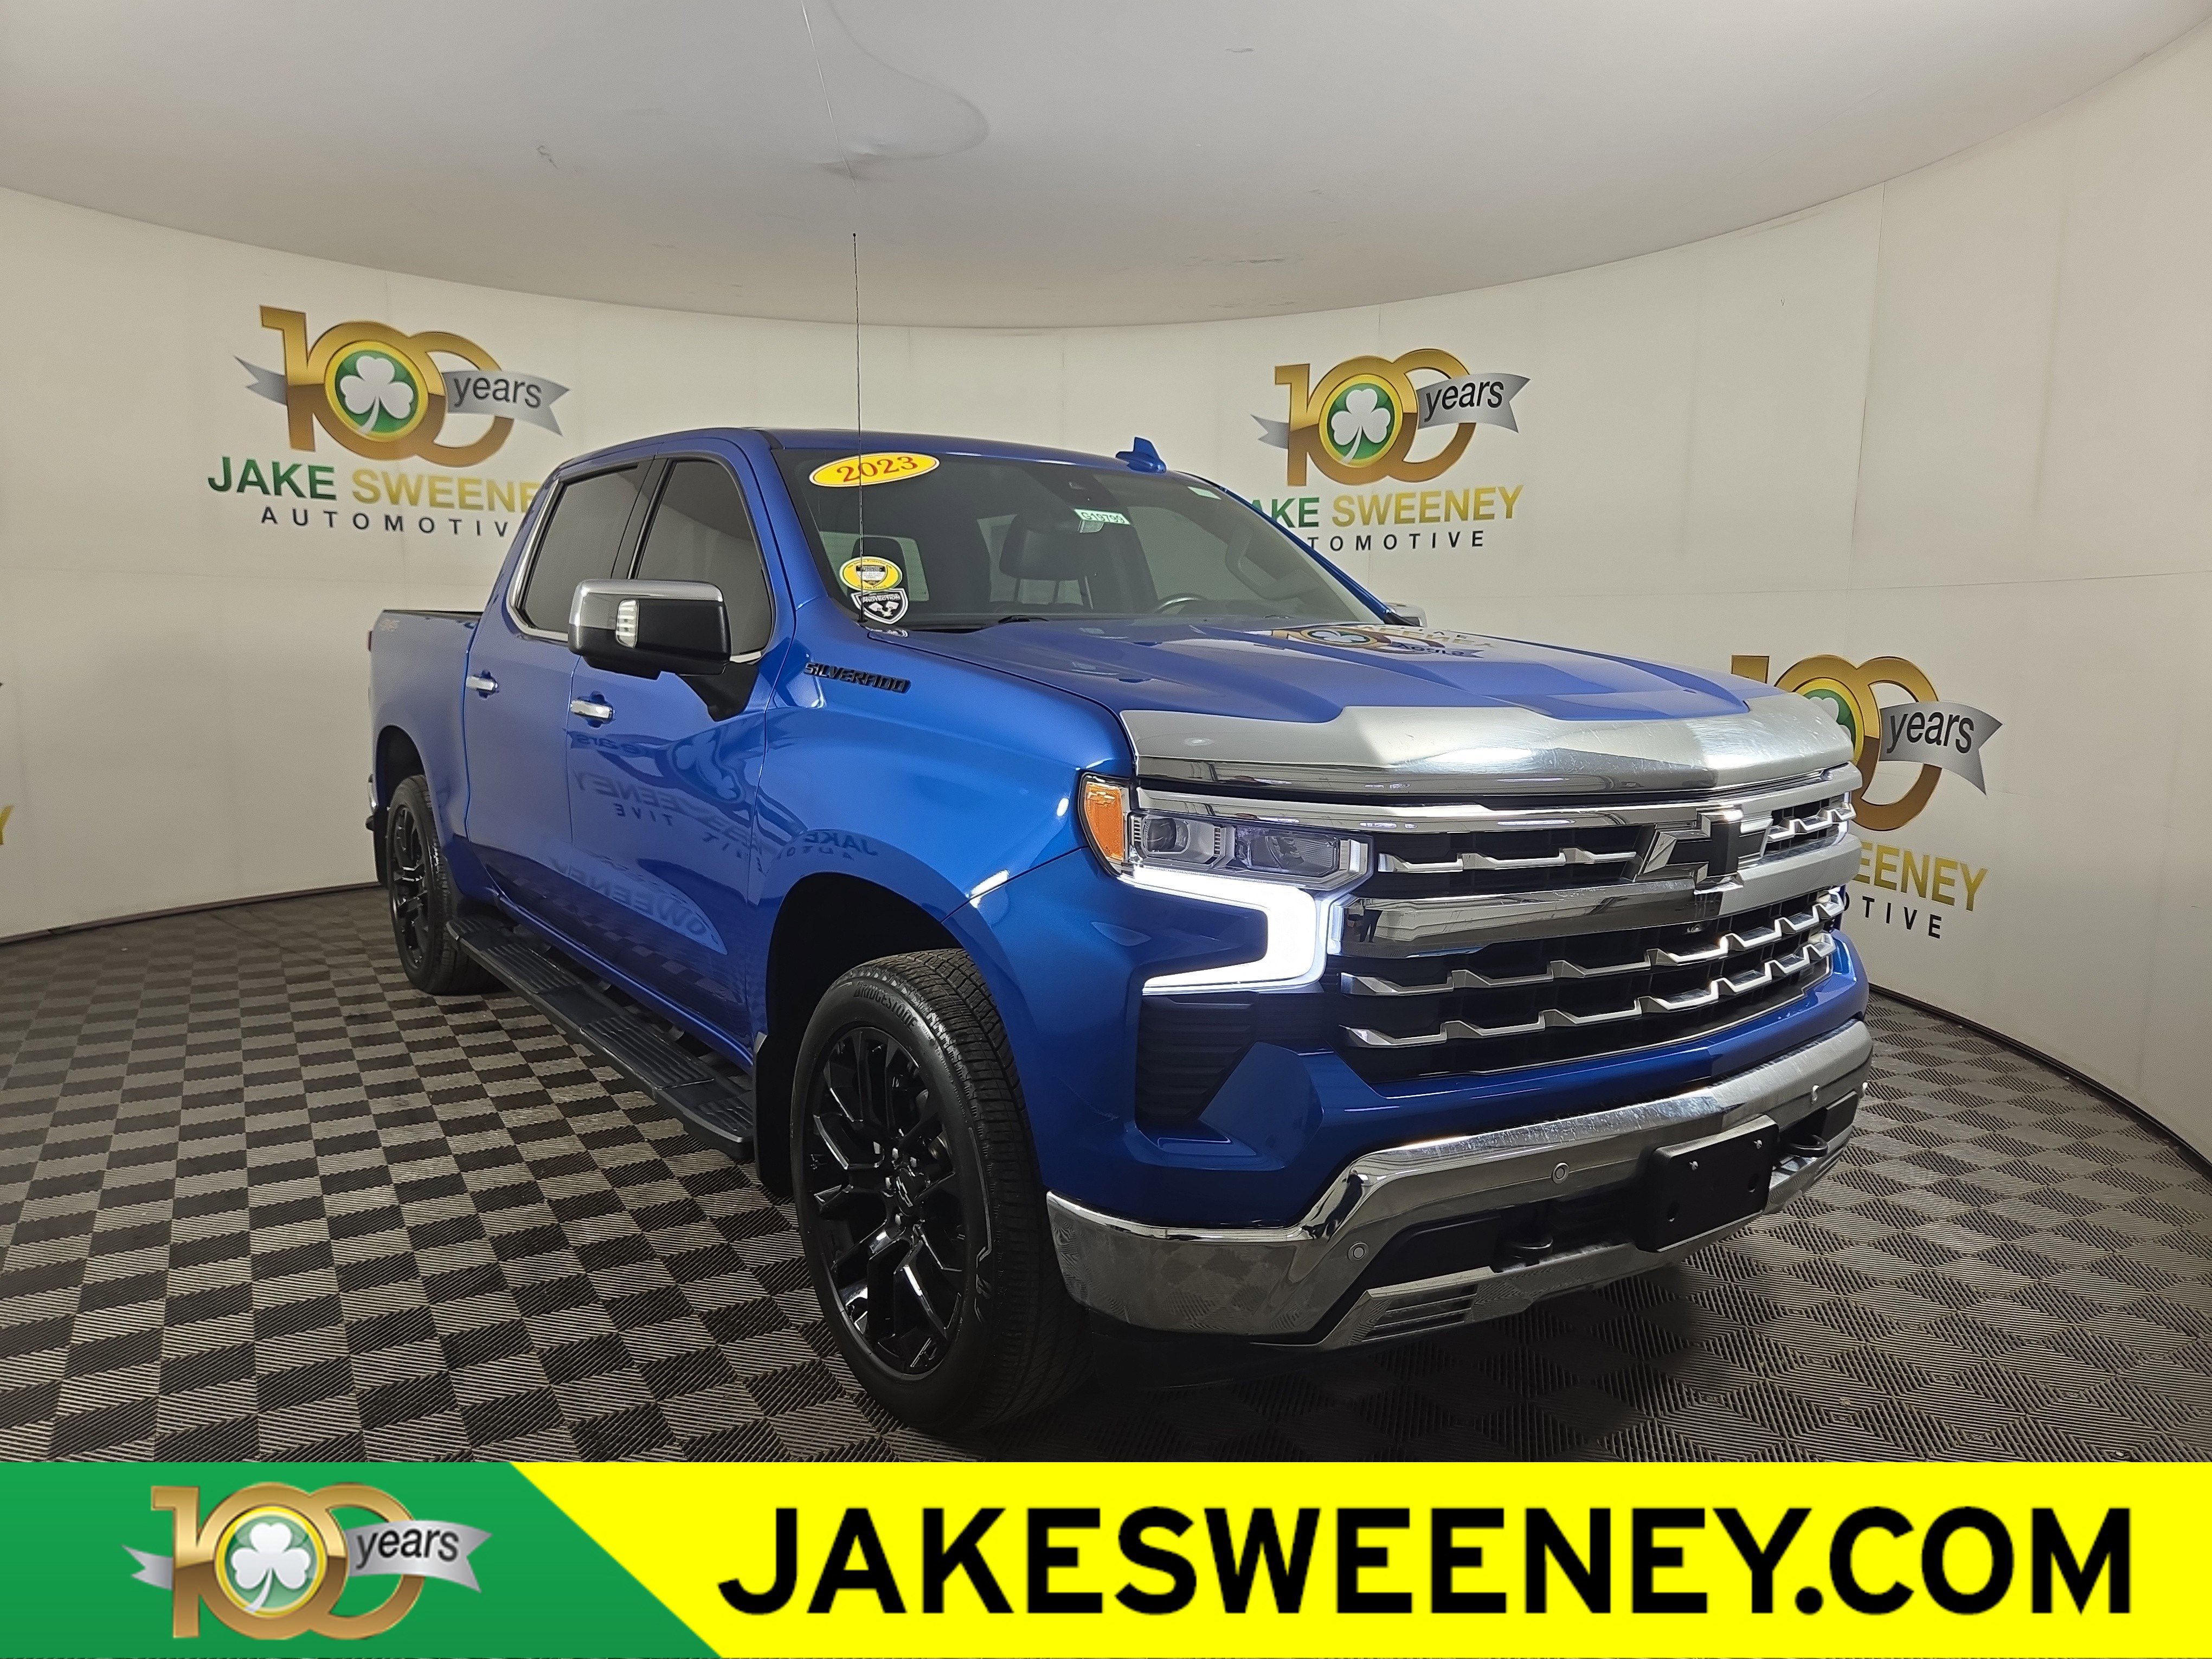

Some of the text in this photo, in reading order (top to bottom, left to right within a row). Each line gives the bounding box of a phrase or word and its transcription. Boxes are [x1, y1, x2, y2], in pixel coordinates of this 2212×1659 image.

[259, 305, 515, 468] 100
[453, 373, 542, 409] years
[1424, 381, 1504, 422] years
[1275, 348, 1477, 486] 100
[208, 456, 542, 513] JAKE SWEENE
[837, 456, 918, 483] 2023
[261, 506, 509, 538] AUTOMOTIV
[1252, 485, 1524, 529] KE SWEENEY
[1307, 530, 1484, 552] TOMOTIVE
[804, 661, 911, 694] SILVERADO
[1731, 654, 1943, 832] 00
[1886, 712, 1975, 754] years
[1852, 841, 1988, 912] ENEY
